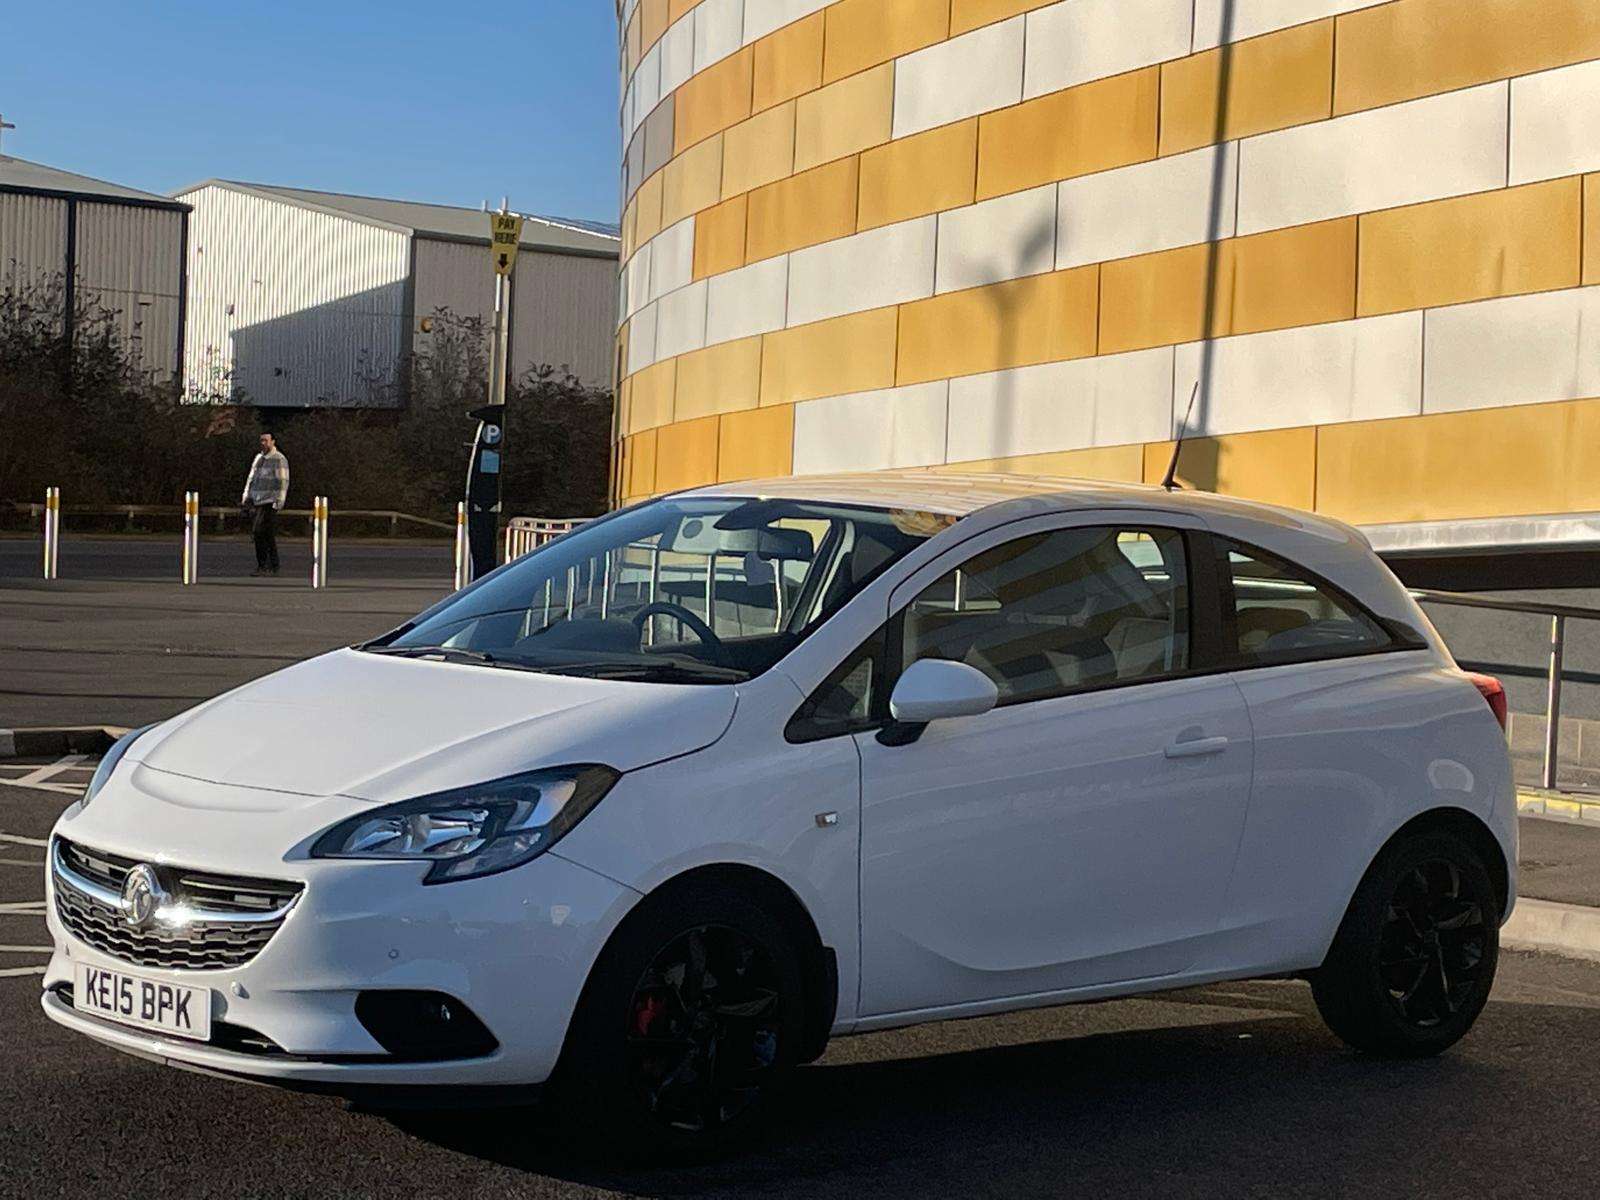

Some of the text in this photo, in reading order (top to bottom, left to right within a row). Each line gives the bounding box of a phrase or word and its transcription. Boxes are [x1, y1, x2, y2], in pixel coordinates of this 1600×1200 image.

[498, 217, 515, 229] PAY
[487, 424, 501, 444] P
[86, 967, 192, 1029] KE15 BPK
